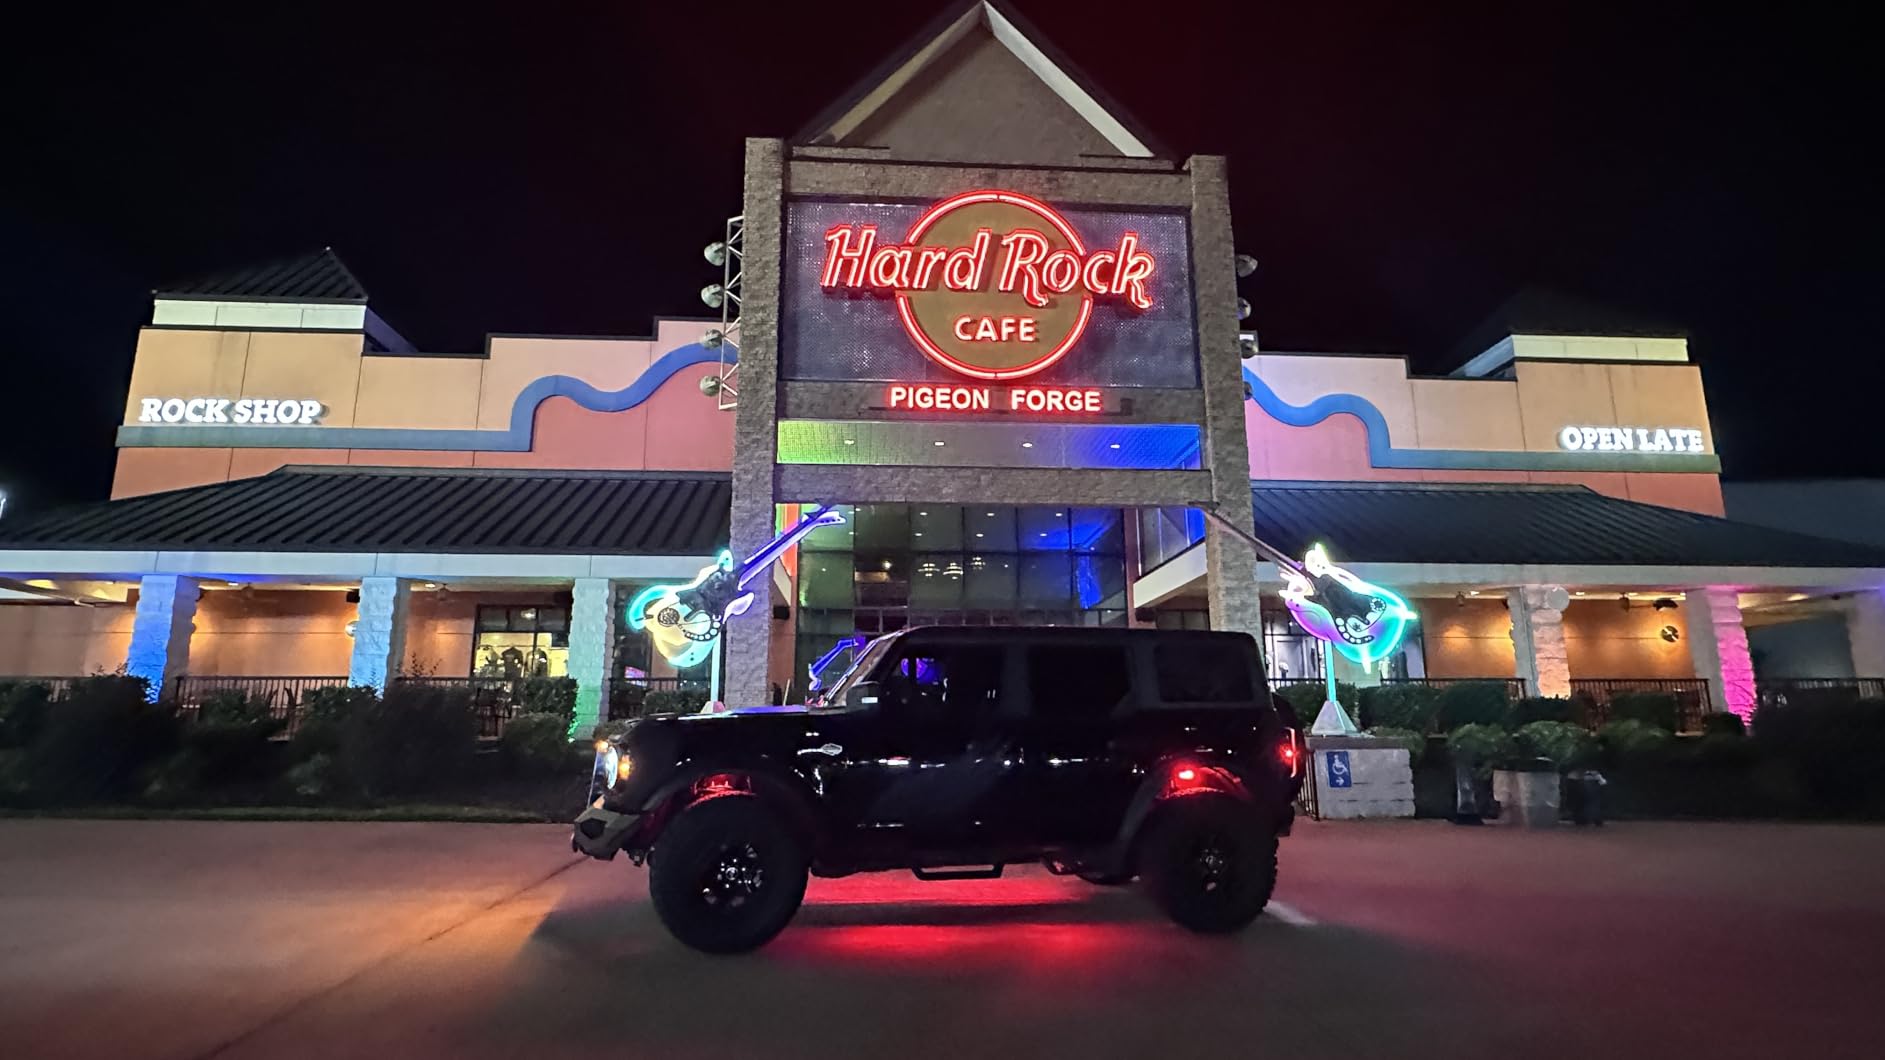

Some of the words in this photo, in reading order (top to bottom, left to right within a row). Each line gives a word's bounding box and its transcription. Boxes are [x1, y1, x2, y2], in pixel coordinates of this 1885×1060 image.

[820, 224, 992, 293] Hard
[998, 228, 1156, 310] Rock
[953, 316, 1036, 342] CAFE
[138, 397, 230, 424] ROCK
[233, 398, 322, 425] SHOP
[889, 386, 990, 411] PIGEON
[1010, 390, 1101, 412] FORGE
[1560, 426, 1634, 451] OPEN
[1636, 428, 1705, 452] LATE
